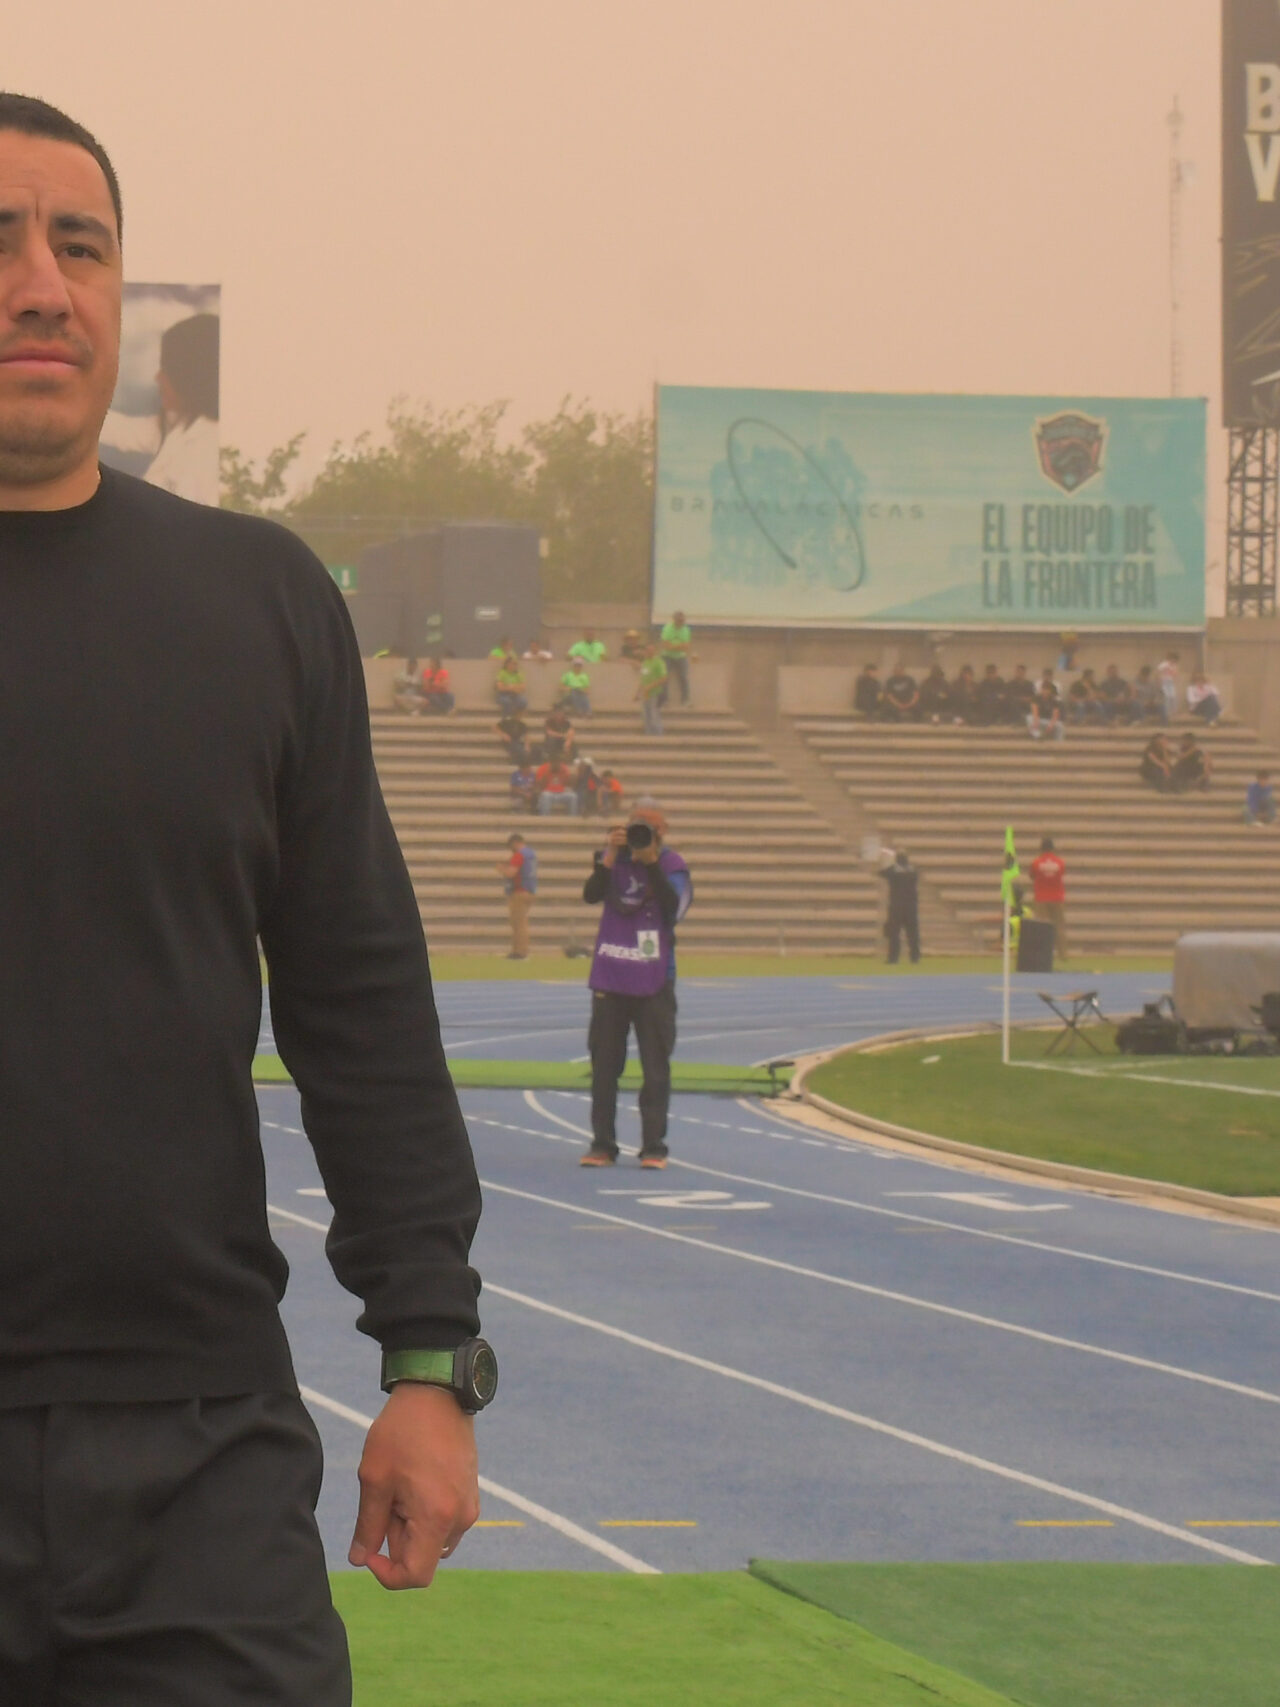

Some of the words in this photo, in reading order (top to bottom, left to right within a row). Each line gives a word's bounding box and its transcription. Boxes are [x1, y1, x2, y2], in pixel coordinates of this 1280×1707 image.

[982, 503, 1010, 554] EL
[1022, 504, 1113, 558] EQUIPO
[1123, 504, 1156, 555] DE
[982, 558, 1013, 609] LA
[1024, 560, 1158, 610] FRONTERA
